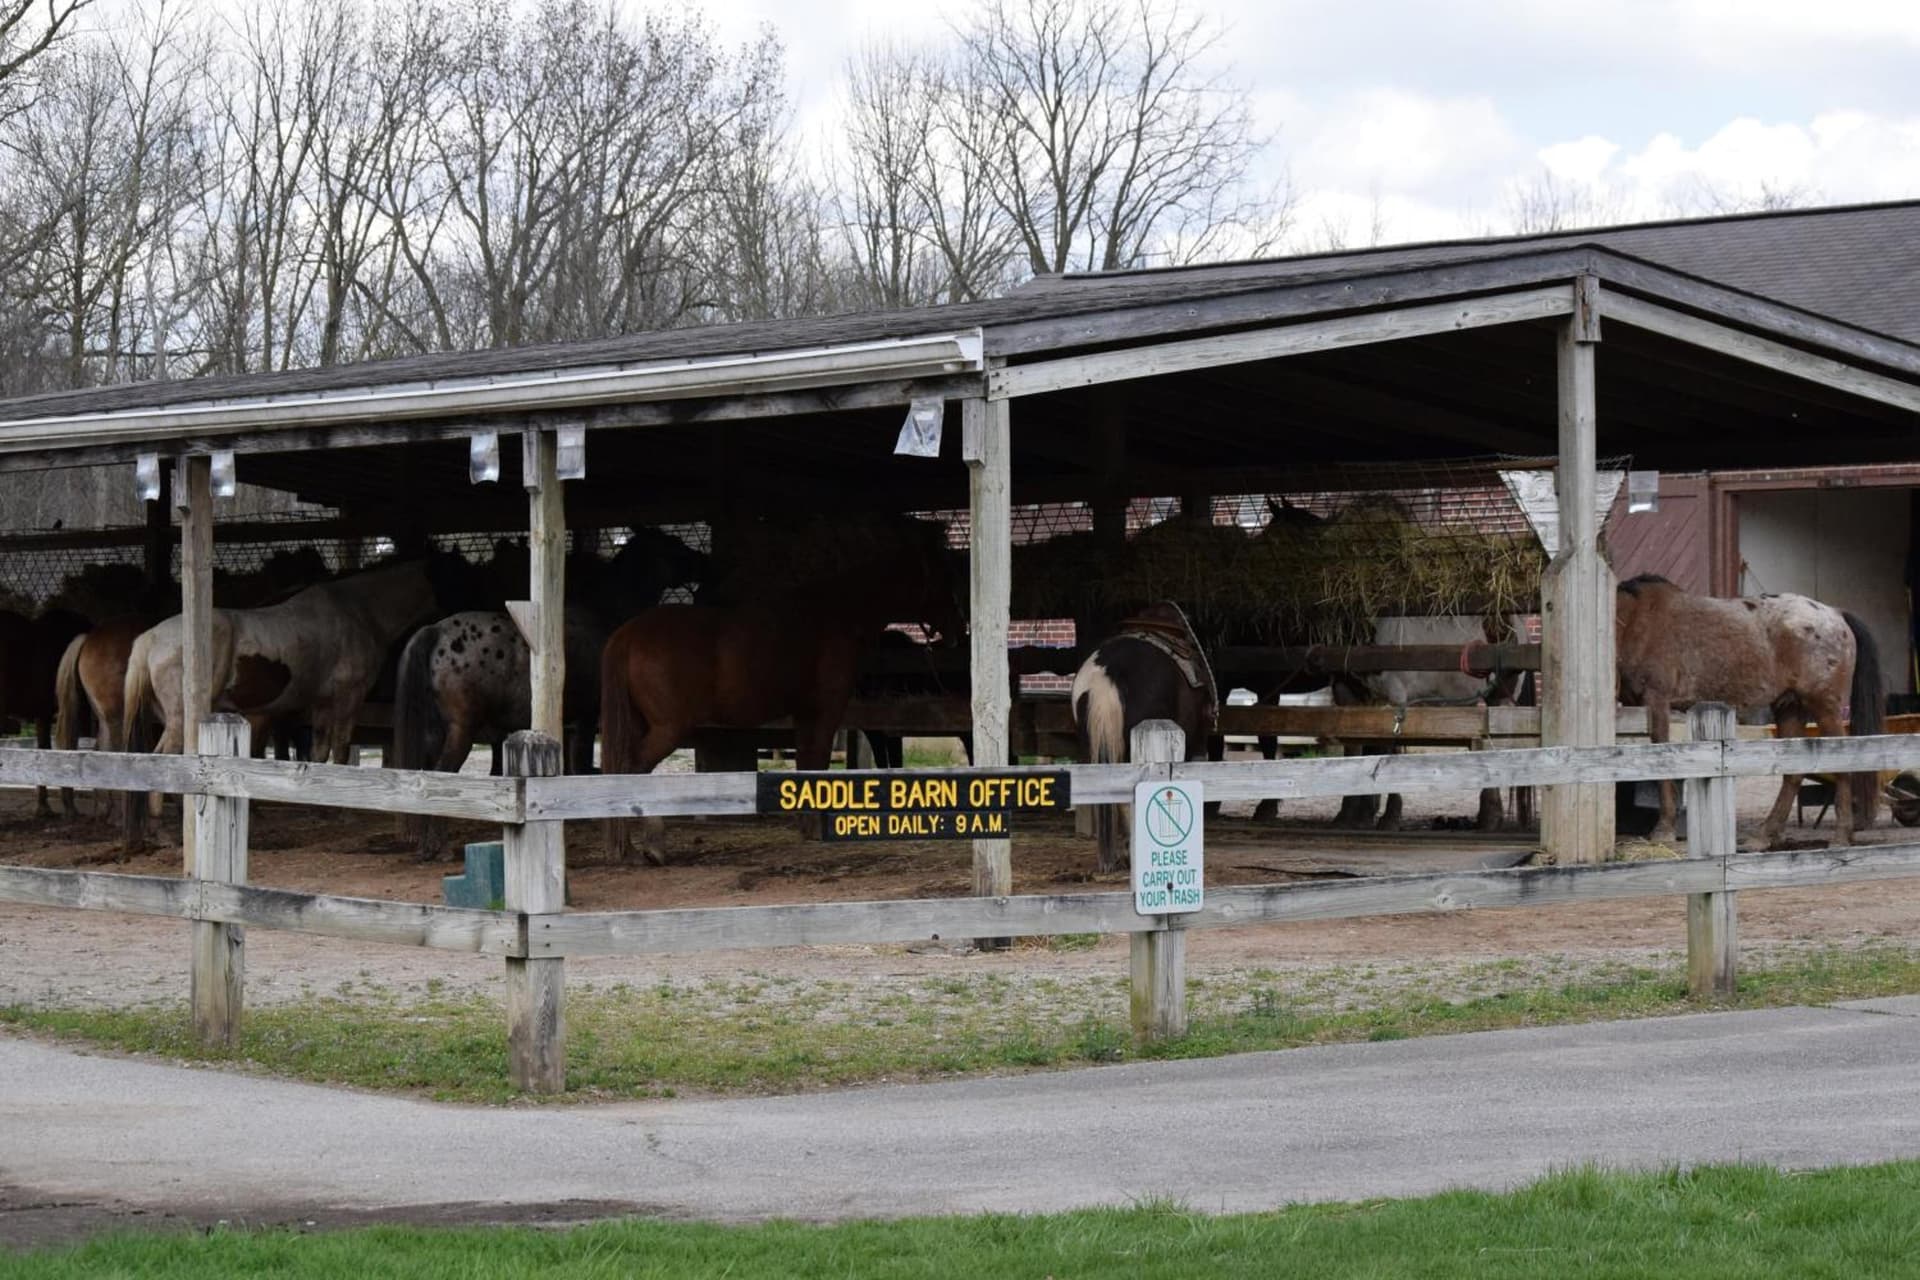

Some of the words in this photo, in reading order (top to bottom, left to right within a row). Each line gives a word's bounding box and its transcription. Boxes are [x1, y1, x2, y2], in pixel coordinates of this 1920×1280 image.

[780, 780, 880, 809] SADDLE
[891, 779, 957, 808] BARN
[969, 778, 1055, 807] OFFICE
[835, 815, 880, 835] OPEN
[889, 814, 945, 835] DAILY:
[1151, 850, 1188, 867] PLEASE
[1142, 870, 1175, 888] CARRY
[1177, 869, 1197, 885] OUT
[1140, 891, 1167, 907] YOUR
[1169, 888, 1200, 905] TRASH
